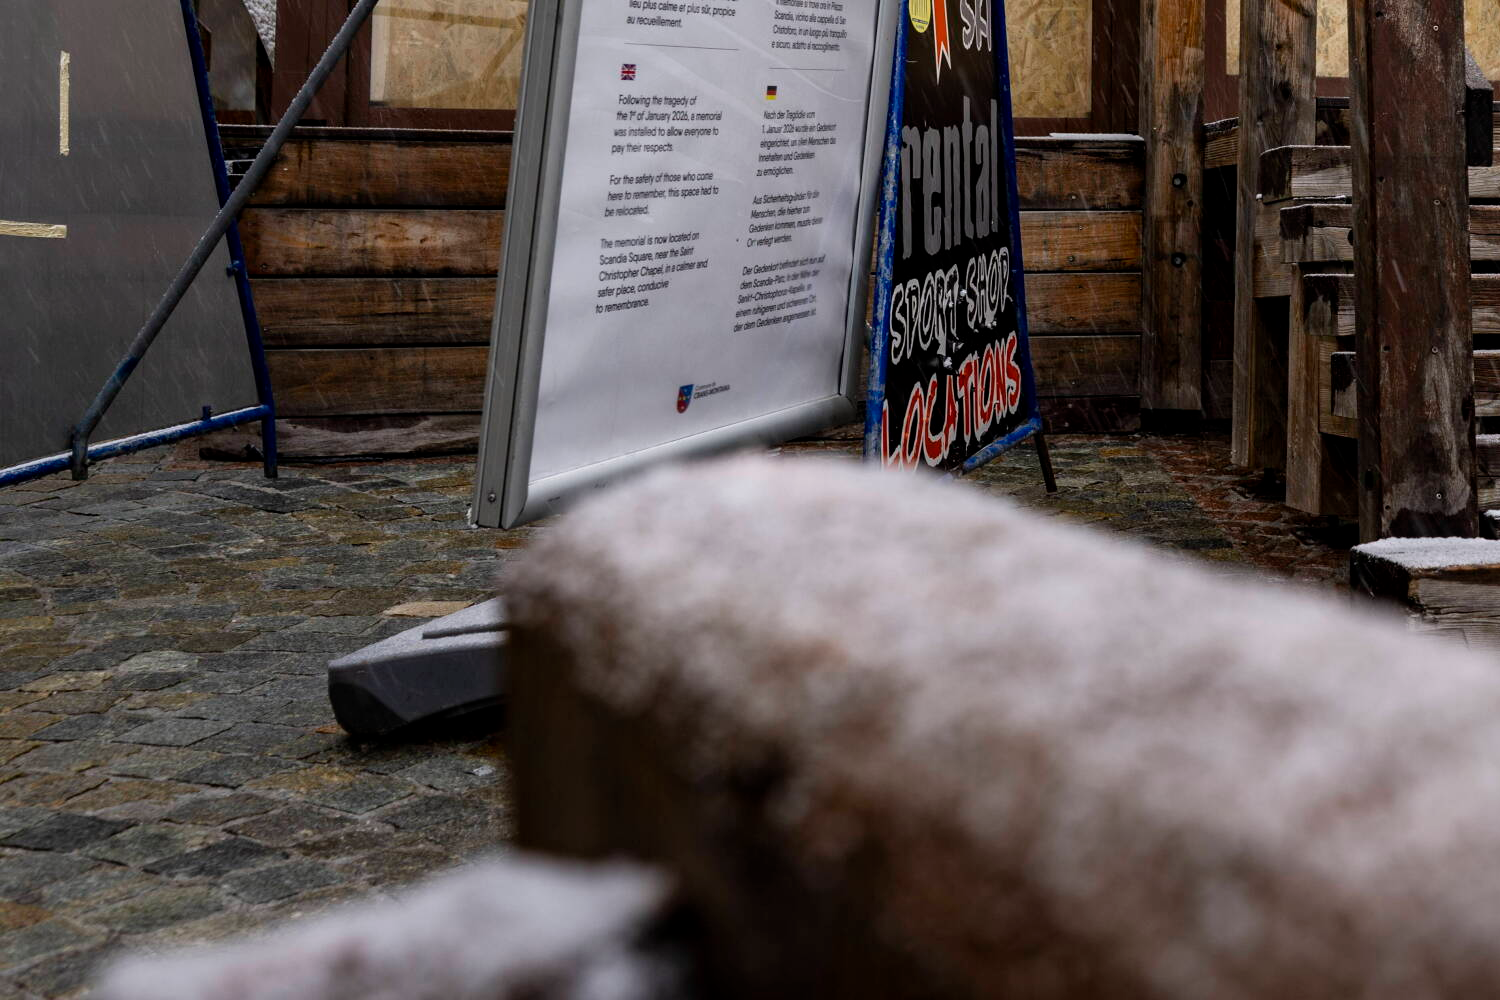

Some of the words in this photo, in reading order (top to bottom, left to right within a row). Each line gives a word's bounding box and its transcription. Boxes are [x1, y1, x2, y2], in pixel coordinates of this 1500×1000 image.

[901, 96, 998, 260] rental
[890, 264, 960, 365] SPORT
[966, 246, 1010, 330] SHOP
[881, 331, 1021, 472] LOCATIONS
